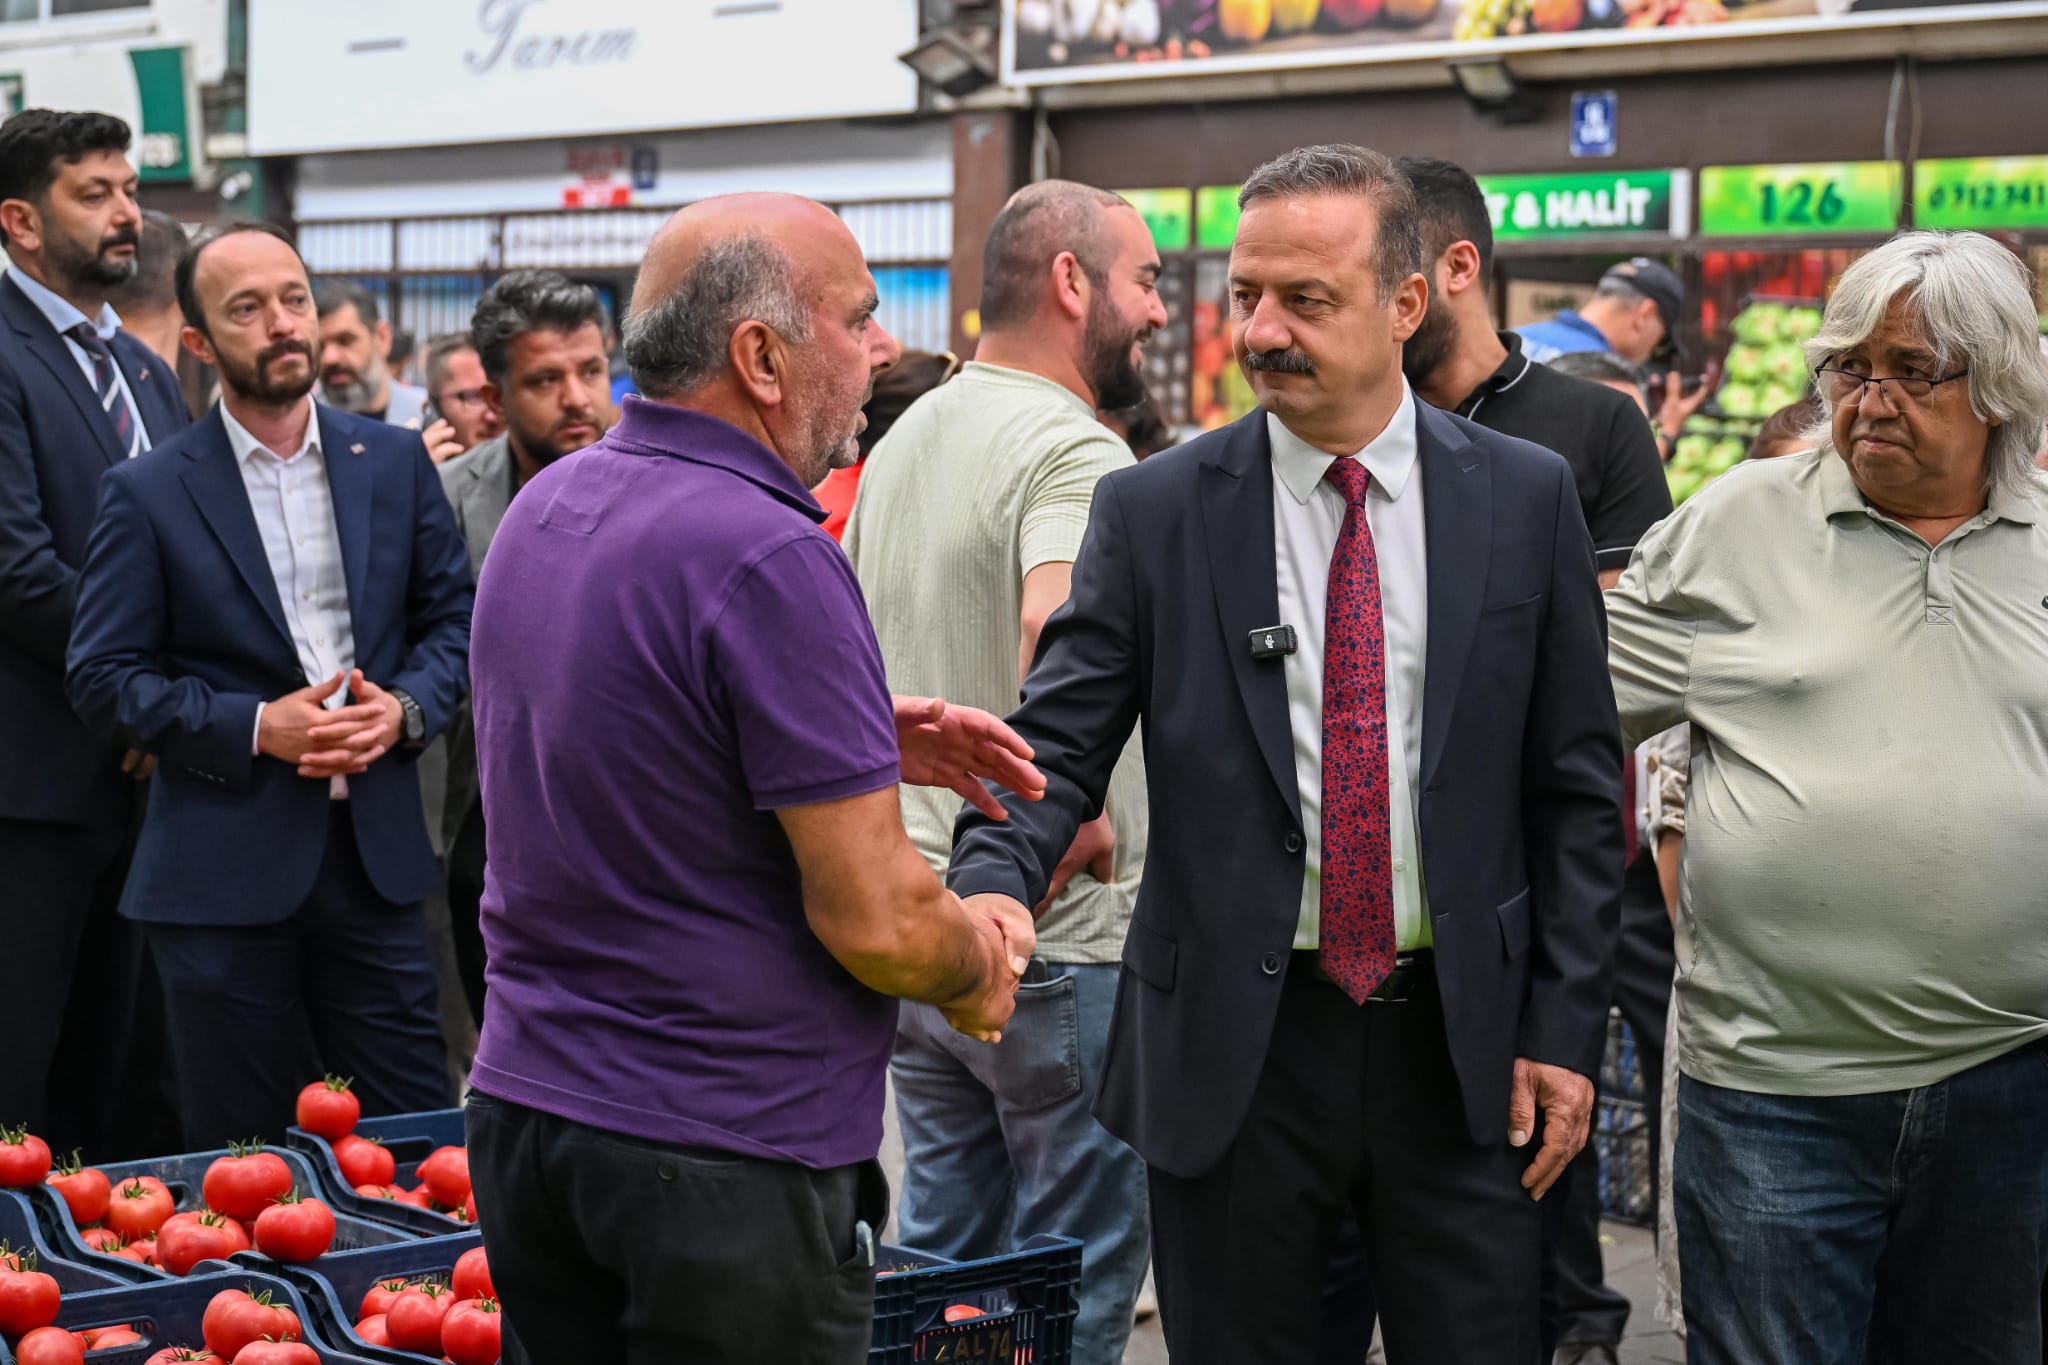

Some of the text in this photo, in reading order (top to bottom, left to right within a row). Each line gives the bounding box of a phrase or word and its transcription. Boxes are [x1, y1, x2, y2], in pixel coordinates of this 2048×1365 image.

[1512, 190, 1541, 228] &
[1545, 179, 1652, 228] HALİT
[1760, 182, 1846, 226] 126
